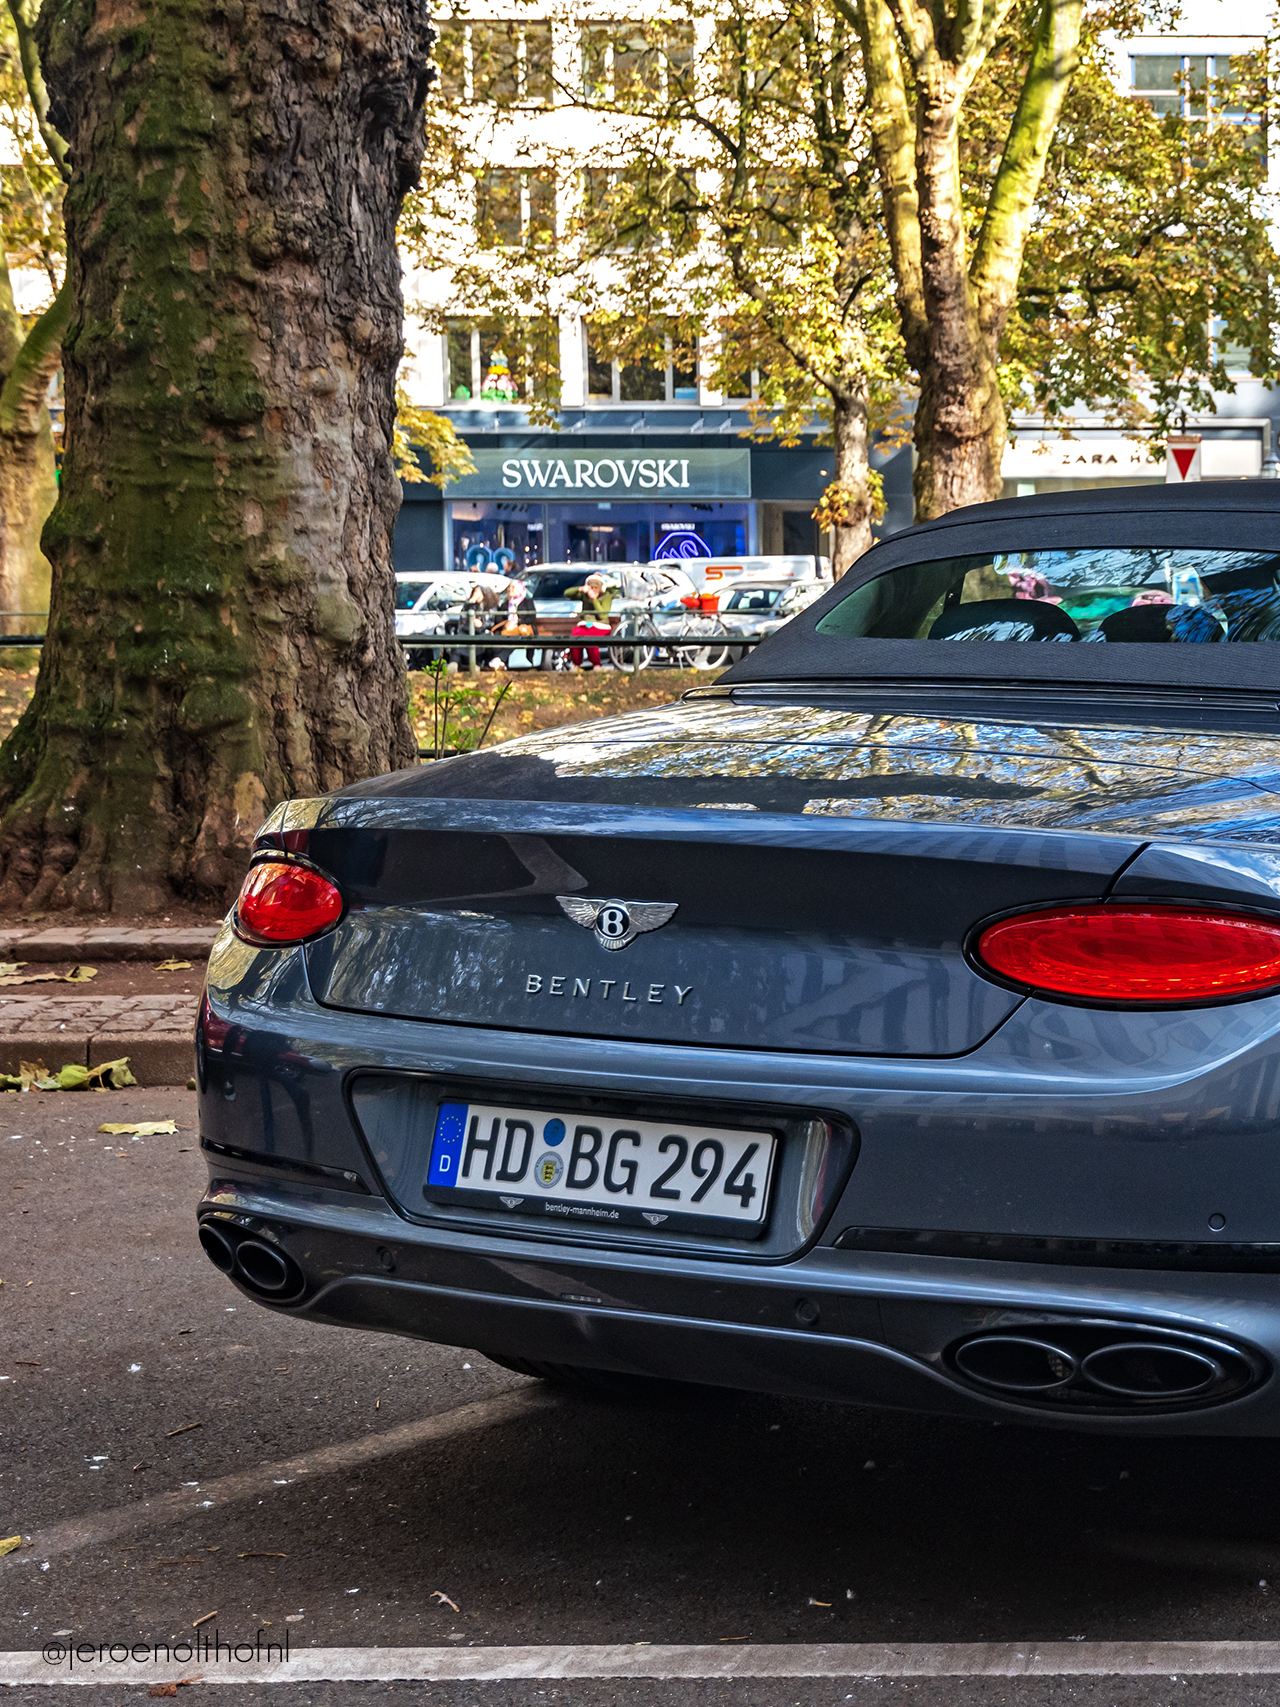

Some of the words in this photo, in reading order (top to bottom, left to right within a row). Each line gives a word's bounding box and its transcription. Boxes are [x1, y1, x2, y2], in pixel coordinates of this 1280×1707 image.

[502, 458, 690, 488] SWAROVSKI
[1062, 454, 1118, 465] ZARA
[1130, 454, 1166, 464] HO
[602, 909, 624, 937] B
[525, 974, 693, 1005] BENTLEY
[439, 1155, 451, 1172] D
[461, 1114, 535, 1182] HD
[565, 1124, 642, 1195] BG
[649, 1133, 761, 1208] 294
[545, 1201, 620, 1220] bentley-mannheim.de
